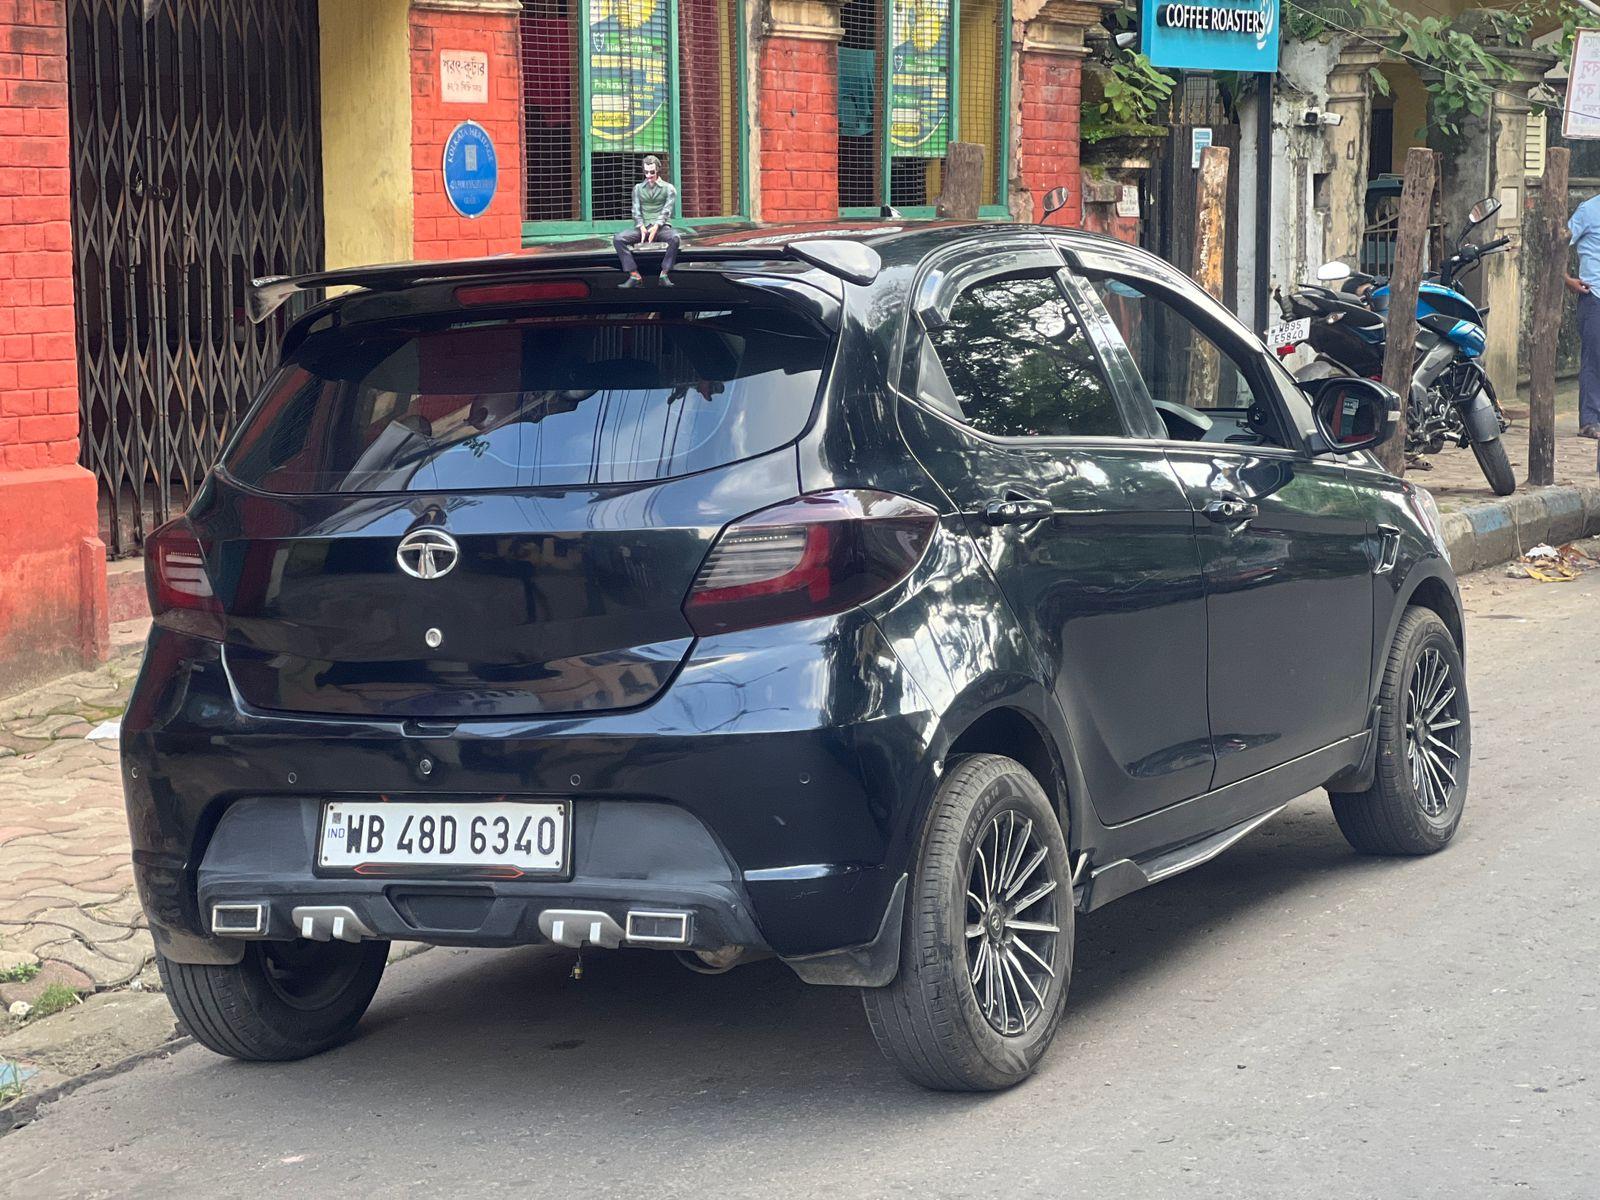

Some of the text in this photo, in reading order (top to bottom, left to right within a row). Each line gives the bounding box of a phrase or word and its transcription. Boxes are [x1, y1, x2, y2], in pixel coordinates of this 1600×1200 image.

[1166, 3, 1266, 33] COFFEE ROASTERS
[1278, 320, 1302, 333] WB95
[1274, 329, 1304, 344] E5840
[327, 827, 345, 839] IND
[346, 814, 556, 856] WB 48D 6340
